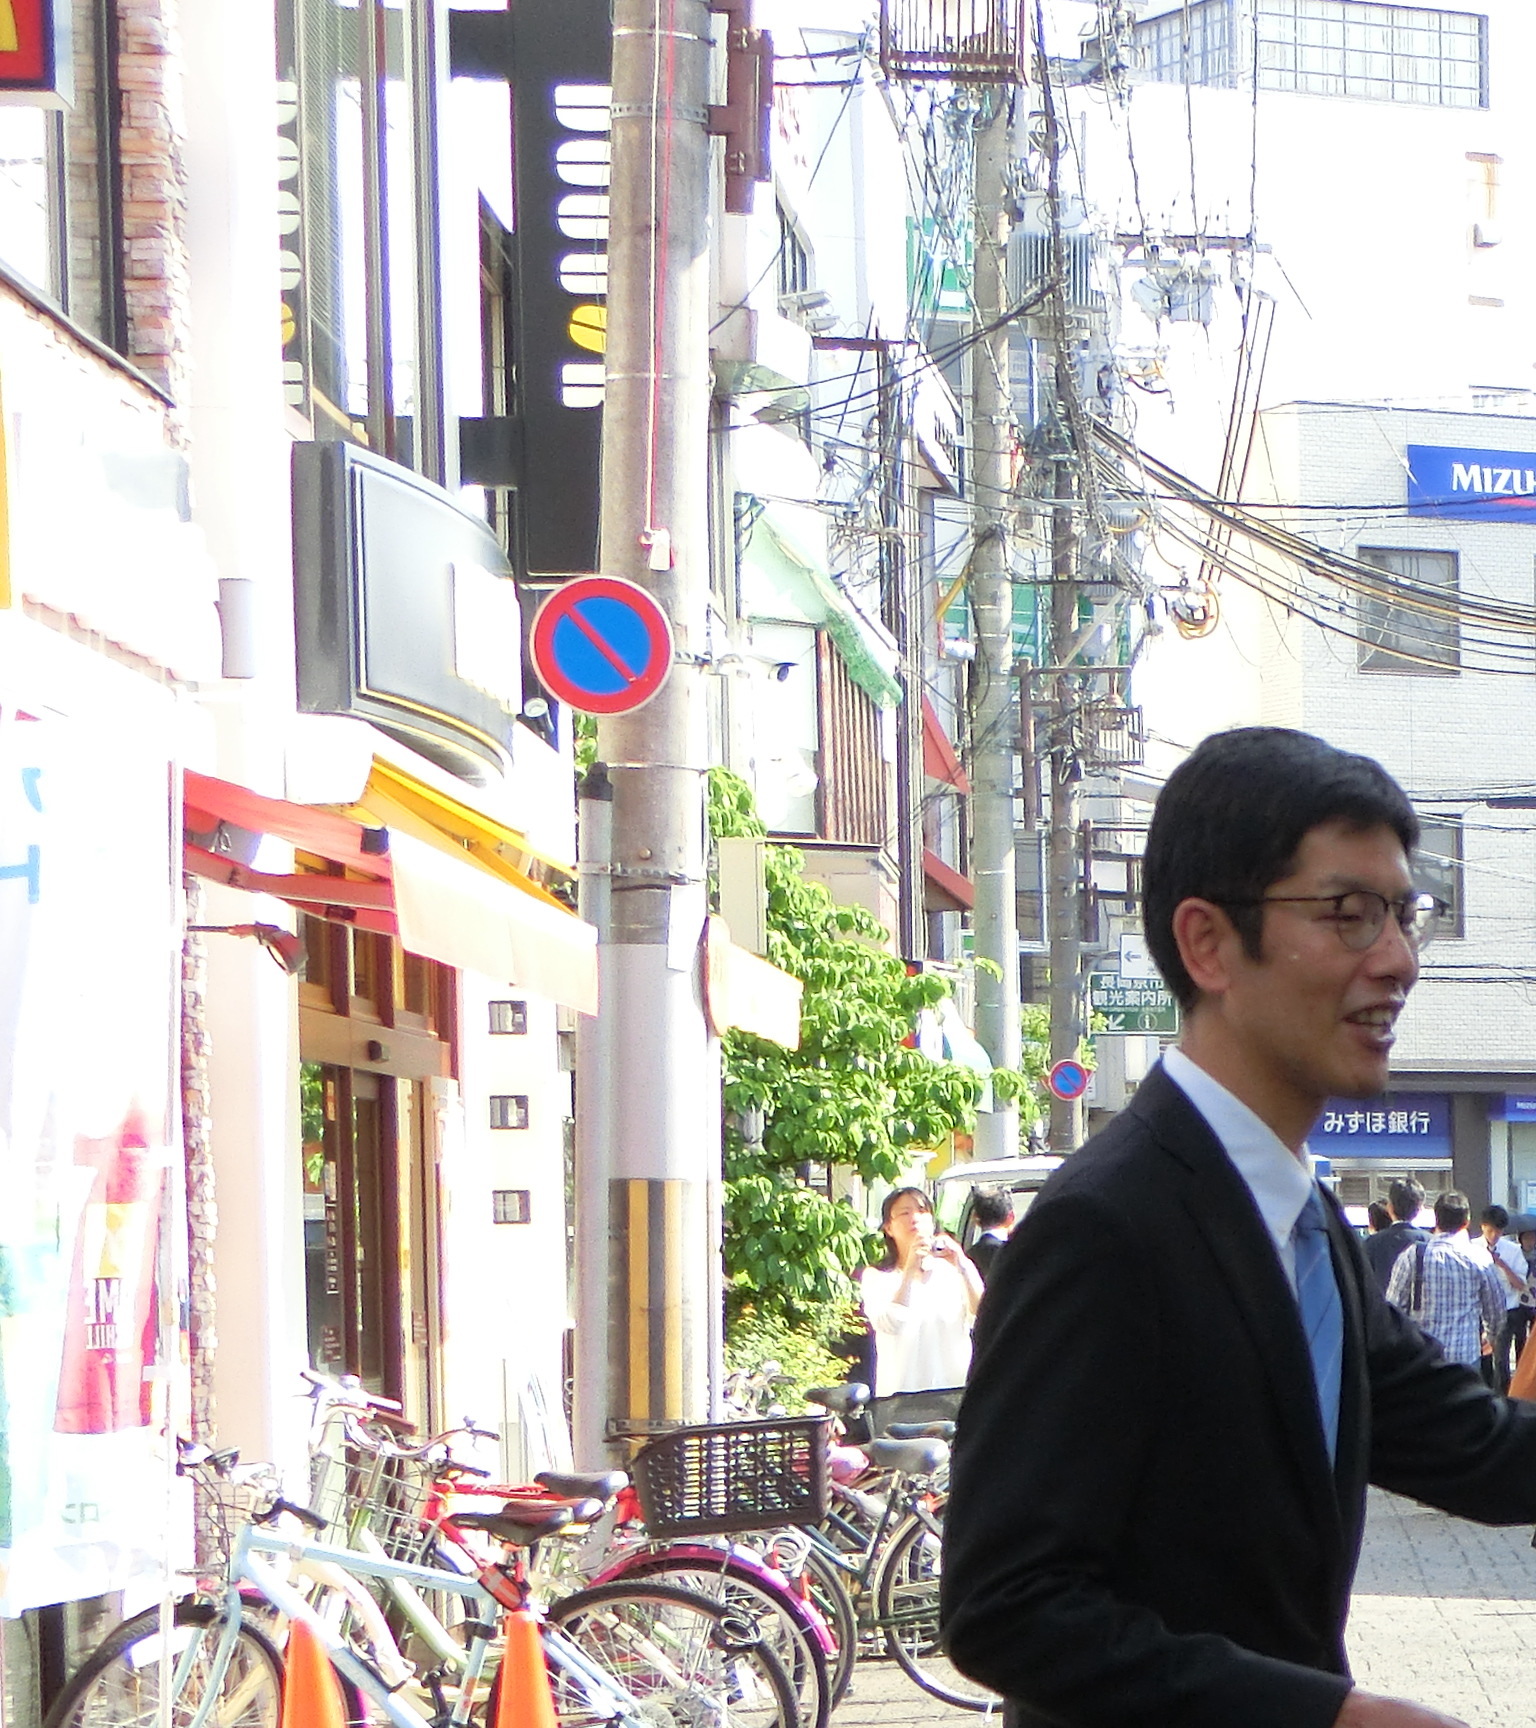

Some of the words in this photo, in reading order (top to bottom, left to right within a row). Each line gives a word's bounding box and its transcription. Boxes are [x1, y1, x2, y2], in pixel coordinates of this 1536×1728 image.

[1093, 991, 1173, 1006] 観光案内所
[1323, 1109, 1431, 1135] みずほ銀行
